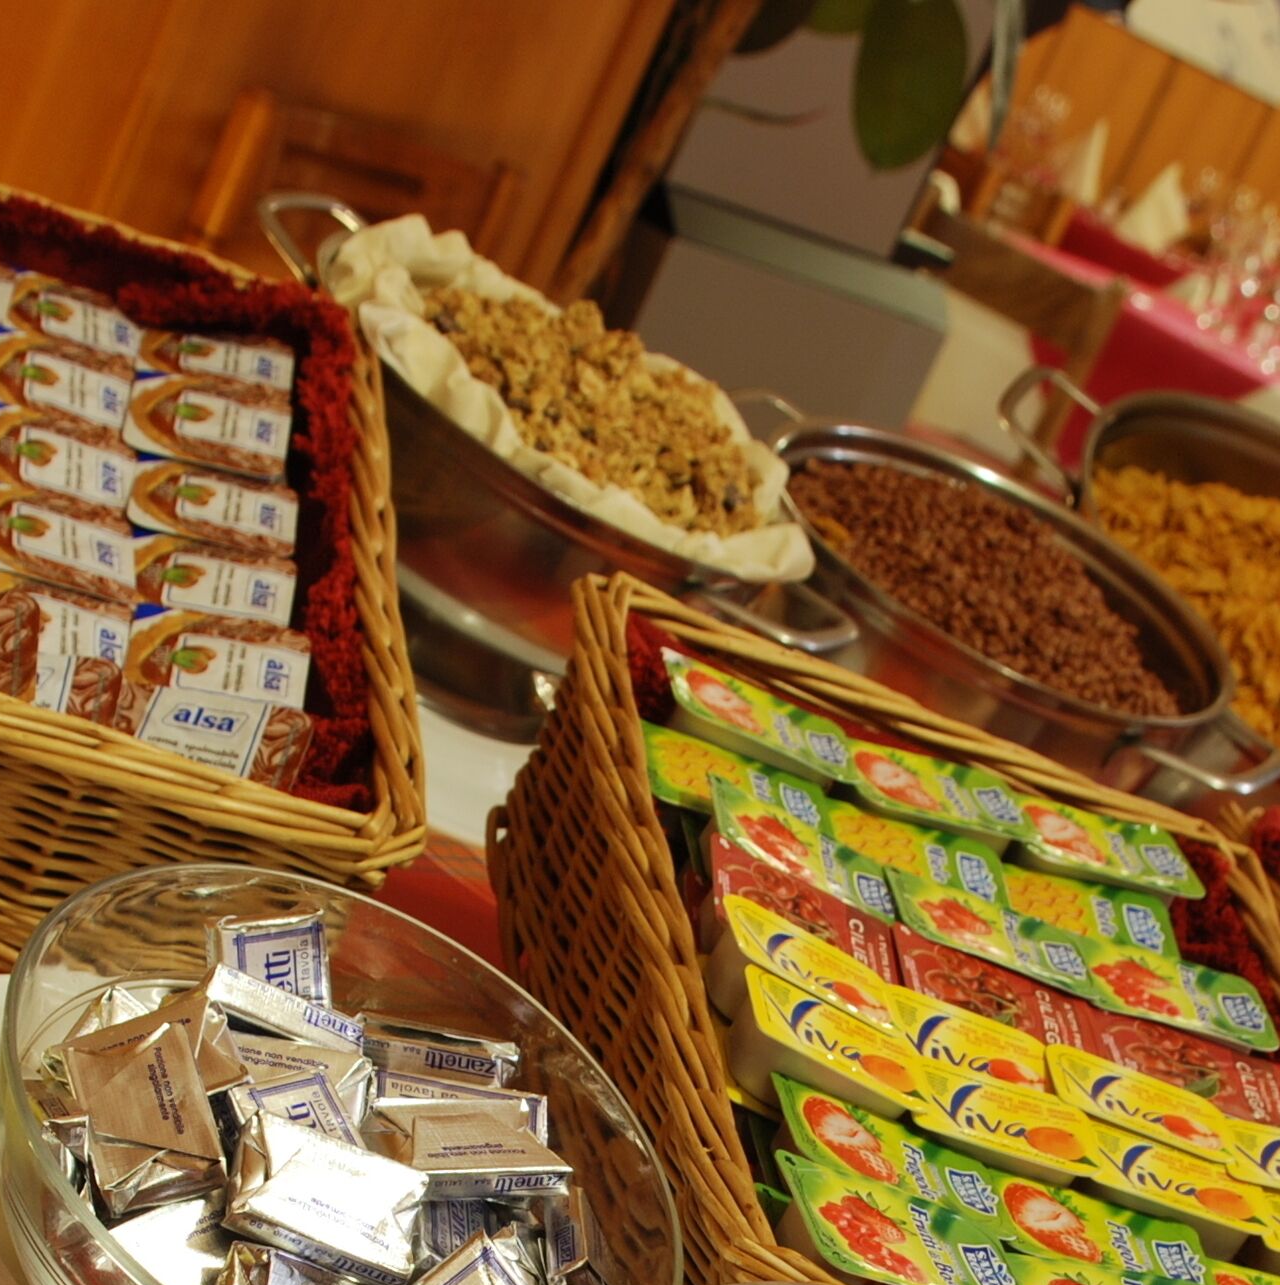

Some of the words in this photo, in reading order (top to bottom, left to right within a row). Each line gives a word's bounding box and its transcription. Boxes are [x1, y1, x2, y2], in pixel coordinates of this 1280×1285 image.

[264, 659, 289, 691] alsa
[173, 707, 236, 732] alsa
[849, 918, 869, 966] CILIE
[265, 950, 293, 994] etti
[300, 938, 311, 982] tavola
[304, 1006, 365, 1043] zanetti
[1036, 990, 1061, 1045] CILIEG
[265, 1050, 284, 1061] non
[425, 1047, 497, 1075] zanetti
[391, 1082, 437, 1098] tavola
[494, 1173, 566, 1194] zanetti
[910, 1205, 942, 1251] Frutti
